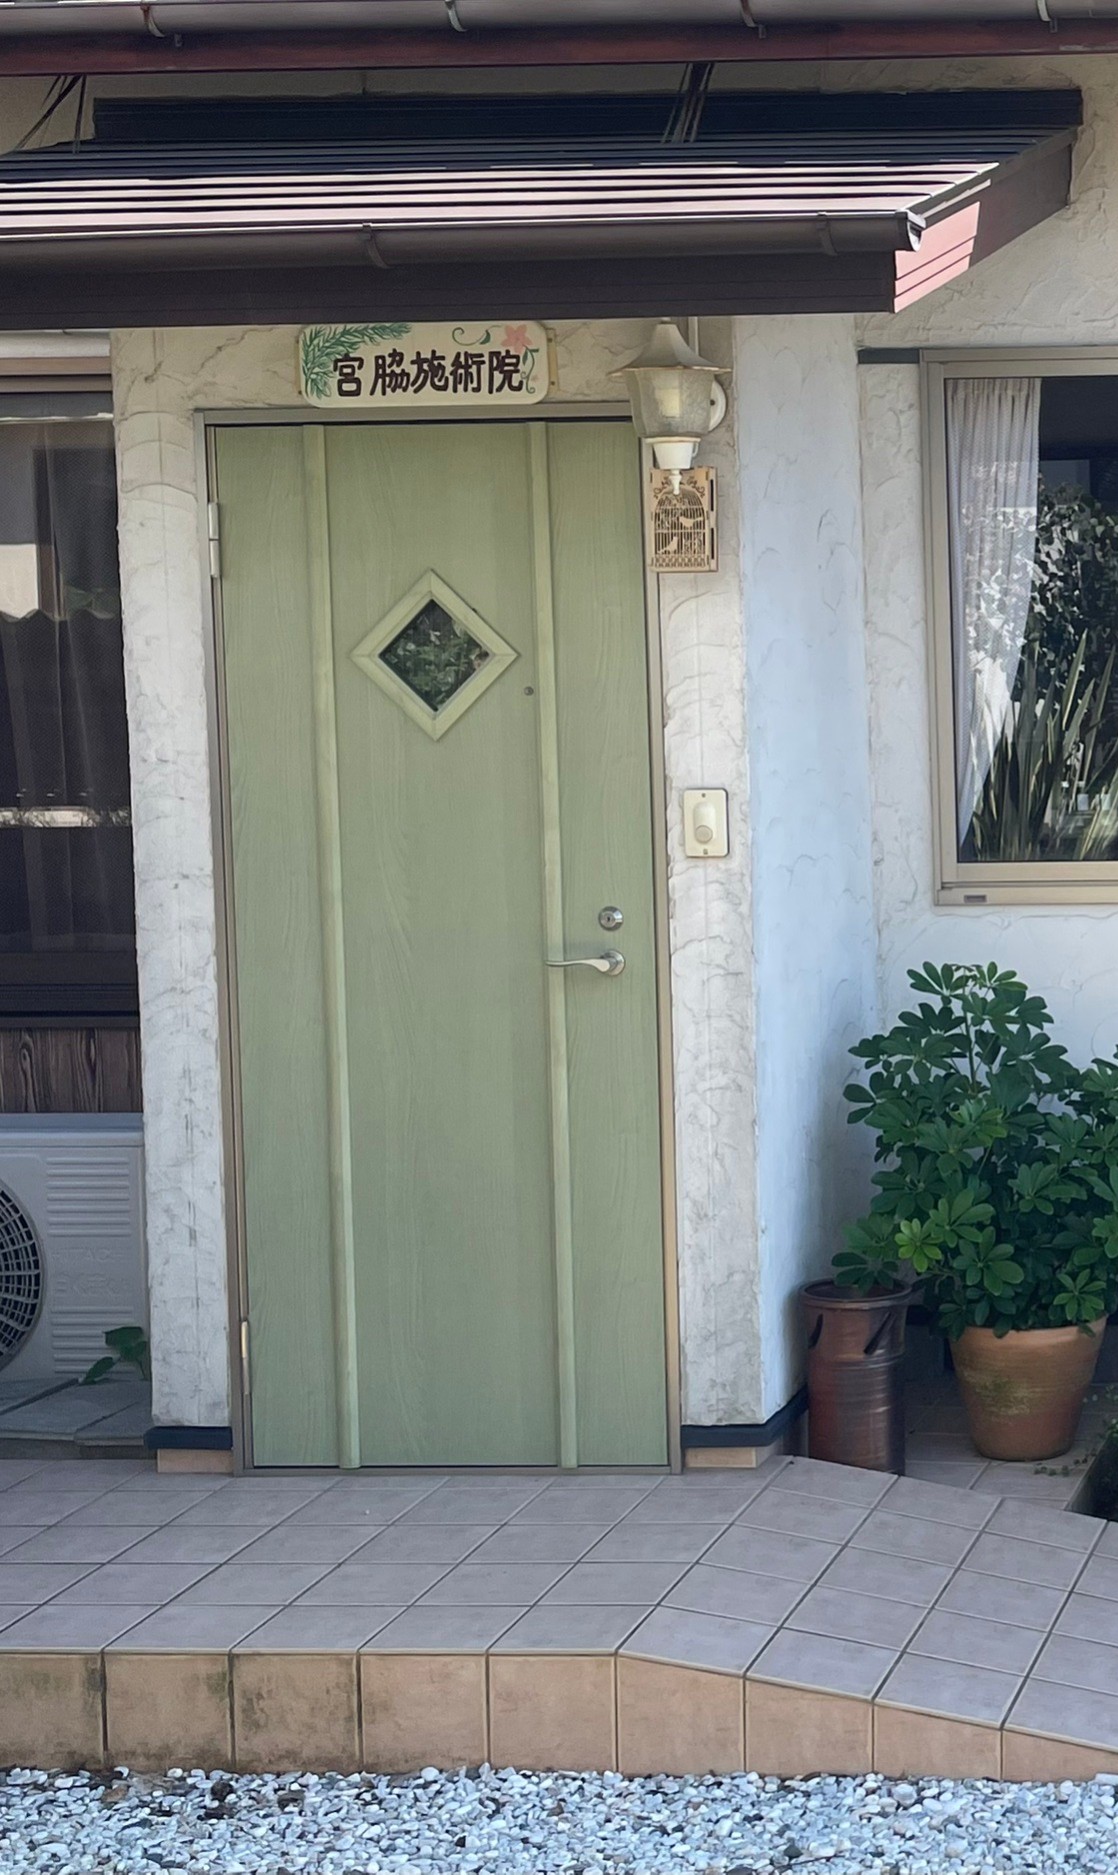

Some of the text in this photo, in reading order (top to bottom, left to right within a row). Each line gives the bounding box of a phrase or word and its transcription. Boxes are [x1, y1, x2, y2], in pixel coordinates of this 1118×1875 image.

[333, 348, 524, 397] 宮脇施術院
